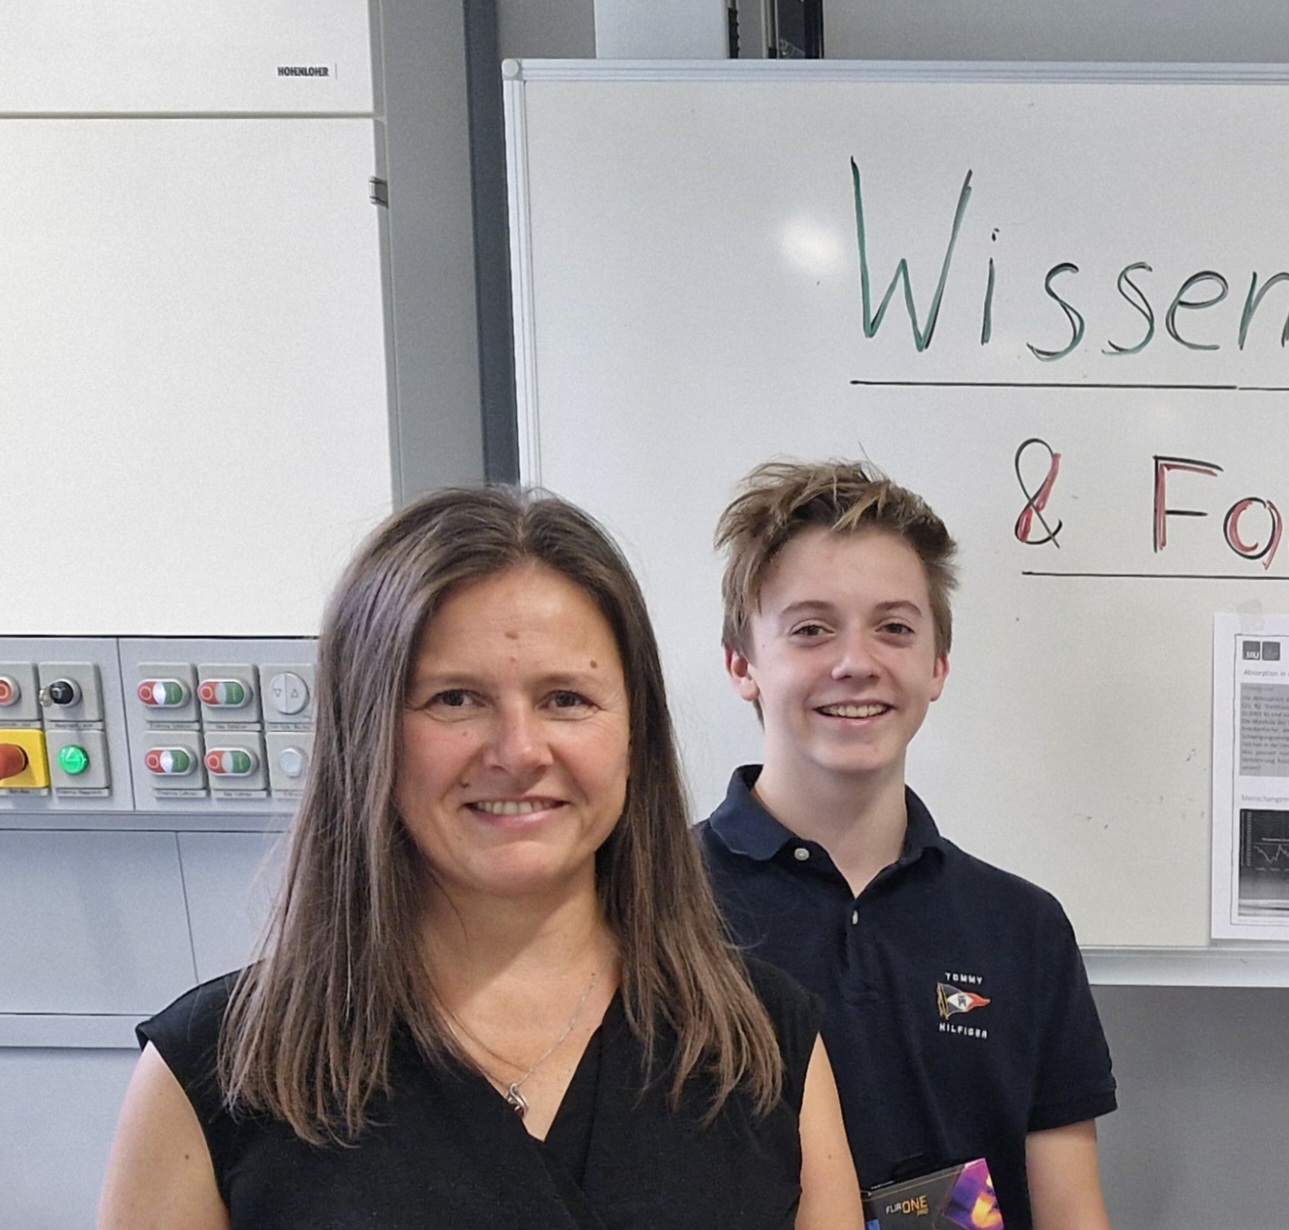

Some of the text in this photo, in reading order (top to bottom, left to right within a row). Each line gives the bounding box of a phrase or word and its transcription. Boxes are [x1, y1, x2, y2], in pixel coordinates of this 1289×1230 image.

[1014, 438, 1062, 549] &
[944, 971, 983, 985] TOMMY
[902, 1195, 929, 1215] ONE
